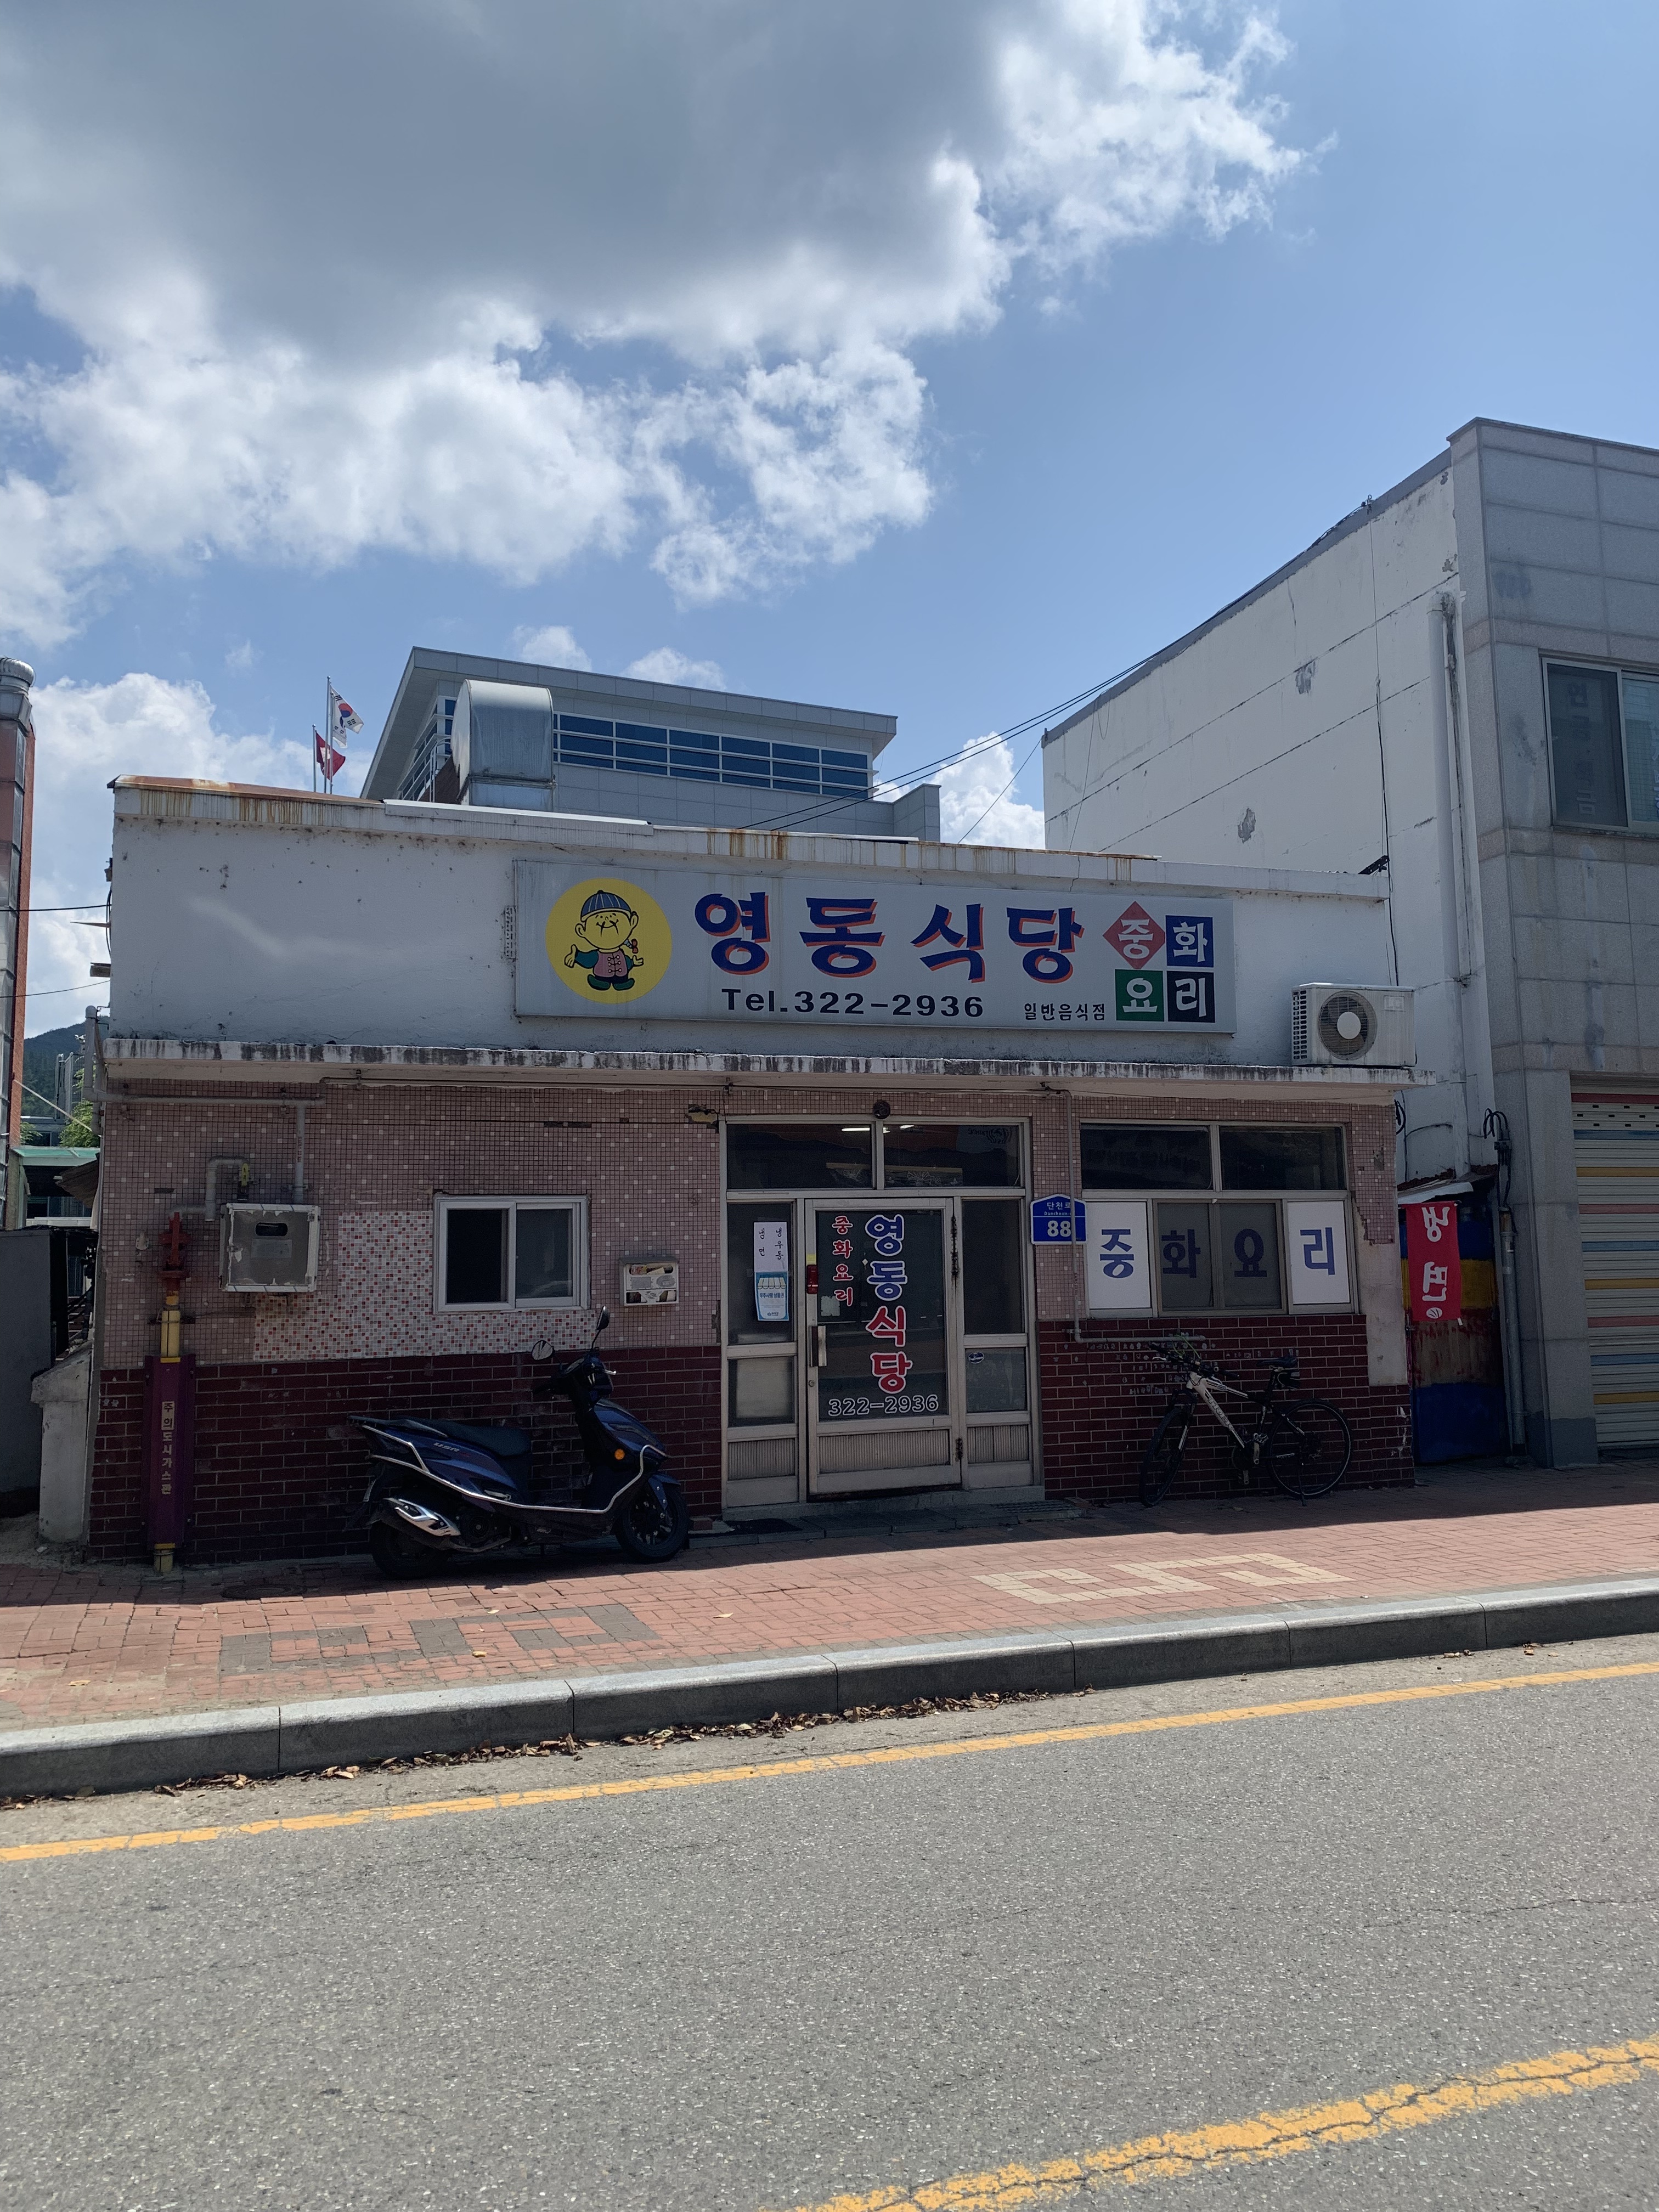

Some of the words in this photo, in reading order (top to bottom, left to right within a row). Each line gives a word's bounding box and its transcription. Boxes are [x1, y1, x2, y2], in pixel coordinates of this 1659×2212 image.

[695, 891, 1085, 984] 영동식당
[1120, 918, 1208, 959] 중화
[721, 988, 983, 1018] Tel.322-2936
[1024, 1003, 1105, 1022] 일반음식점
[1122, 978, 1206, 1017] 요리
[1047, 1220, 1071, 1237] 88
[832, 1216, 854, 1306] 중화요리
[1099, 1227, 1335, 1279] 중화요리
[865, 1214, 913, 1394] 영동식당
[163, 1403, 173, 1427] 주의
[828, 1395, 939, 1417] 322-2936
